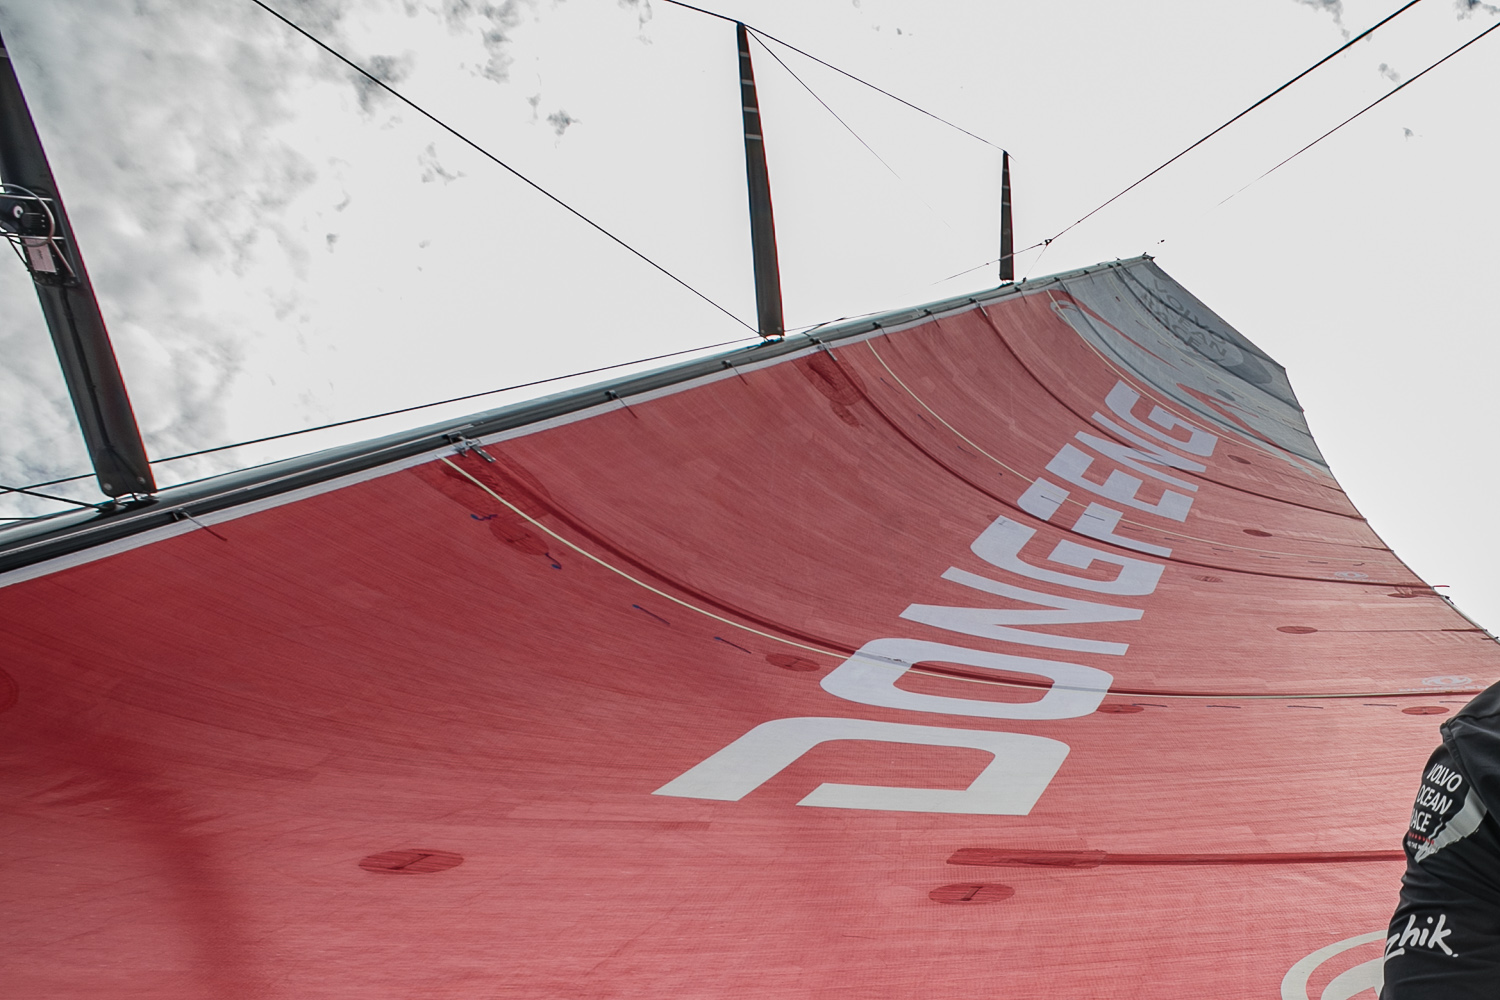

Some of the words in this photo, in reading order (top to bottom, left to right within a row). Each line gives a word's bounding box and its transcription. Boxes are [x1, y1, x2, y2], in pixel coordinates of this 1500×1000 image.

[651, 379, 1220, 816] DONGFENG
[1426, 763, 1463, 792] VOLVO
[1416, 784, 1454, 815] OCEAN
[1410, 808, 1432, 833] ACE
